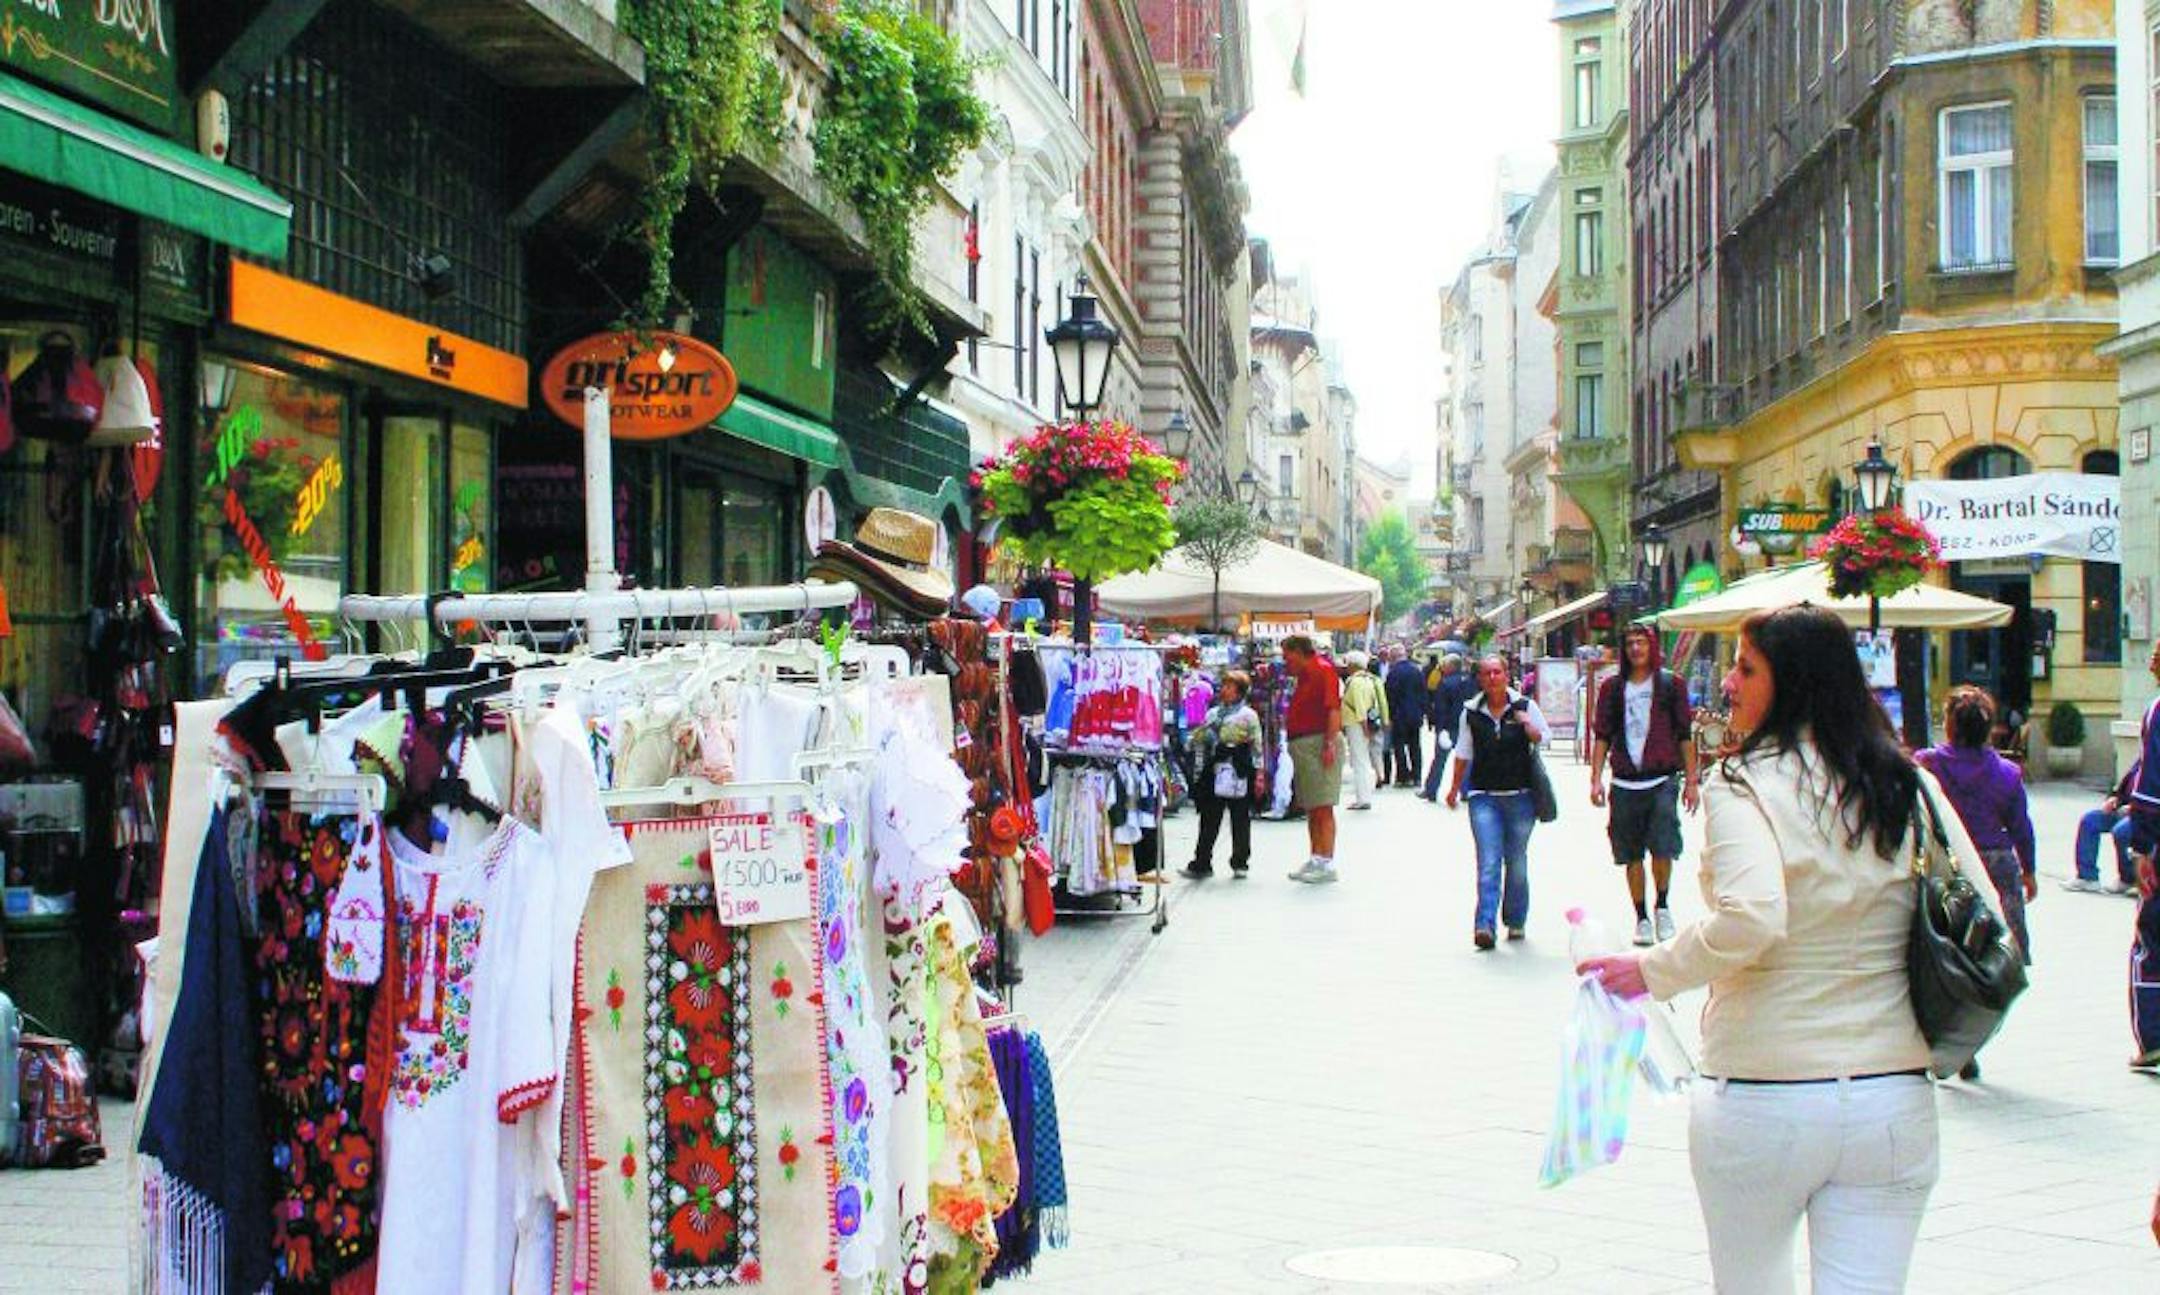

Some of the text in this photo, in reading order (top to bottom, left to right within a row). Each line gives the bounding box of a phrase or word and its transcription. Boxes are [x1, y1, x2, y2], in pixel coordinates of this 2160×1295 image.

[1918, 499, 1950, 521] Dr.
[1960, 494, 2036, 520] Bartal
[1742, 513, 1829, 531] SUBWAY
[712, 828, 775, 853] SALE
[720, 890, 761, 920] 5 EURO
